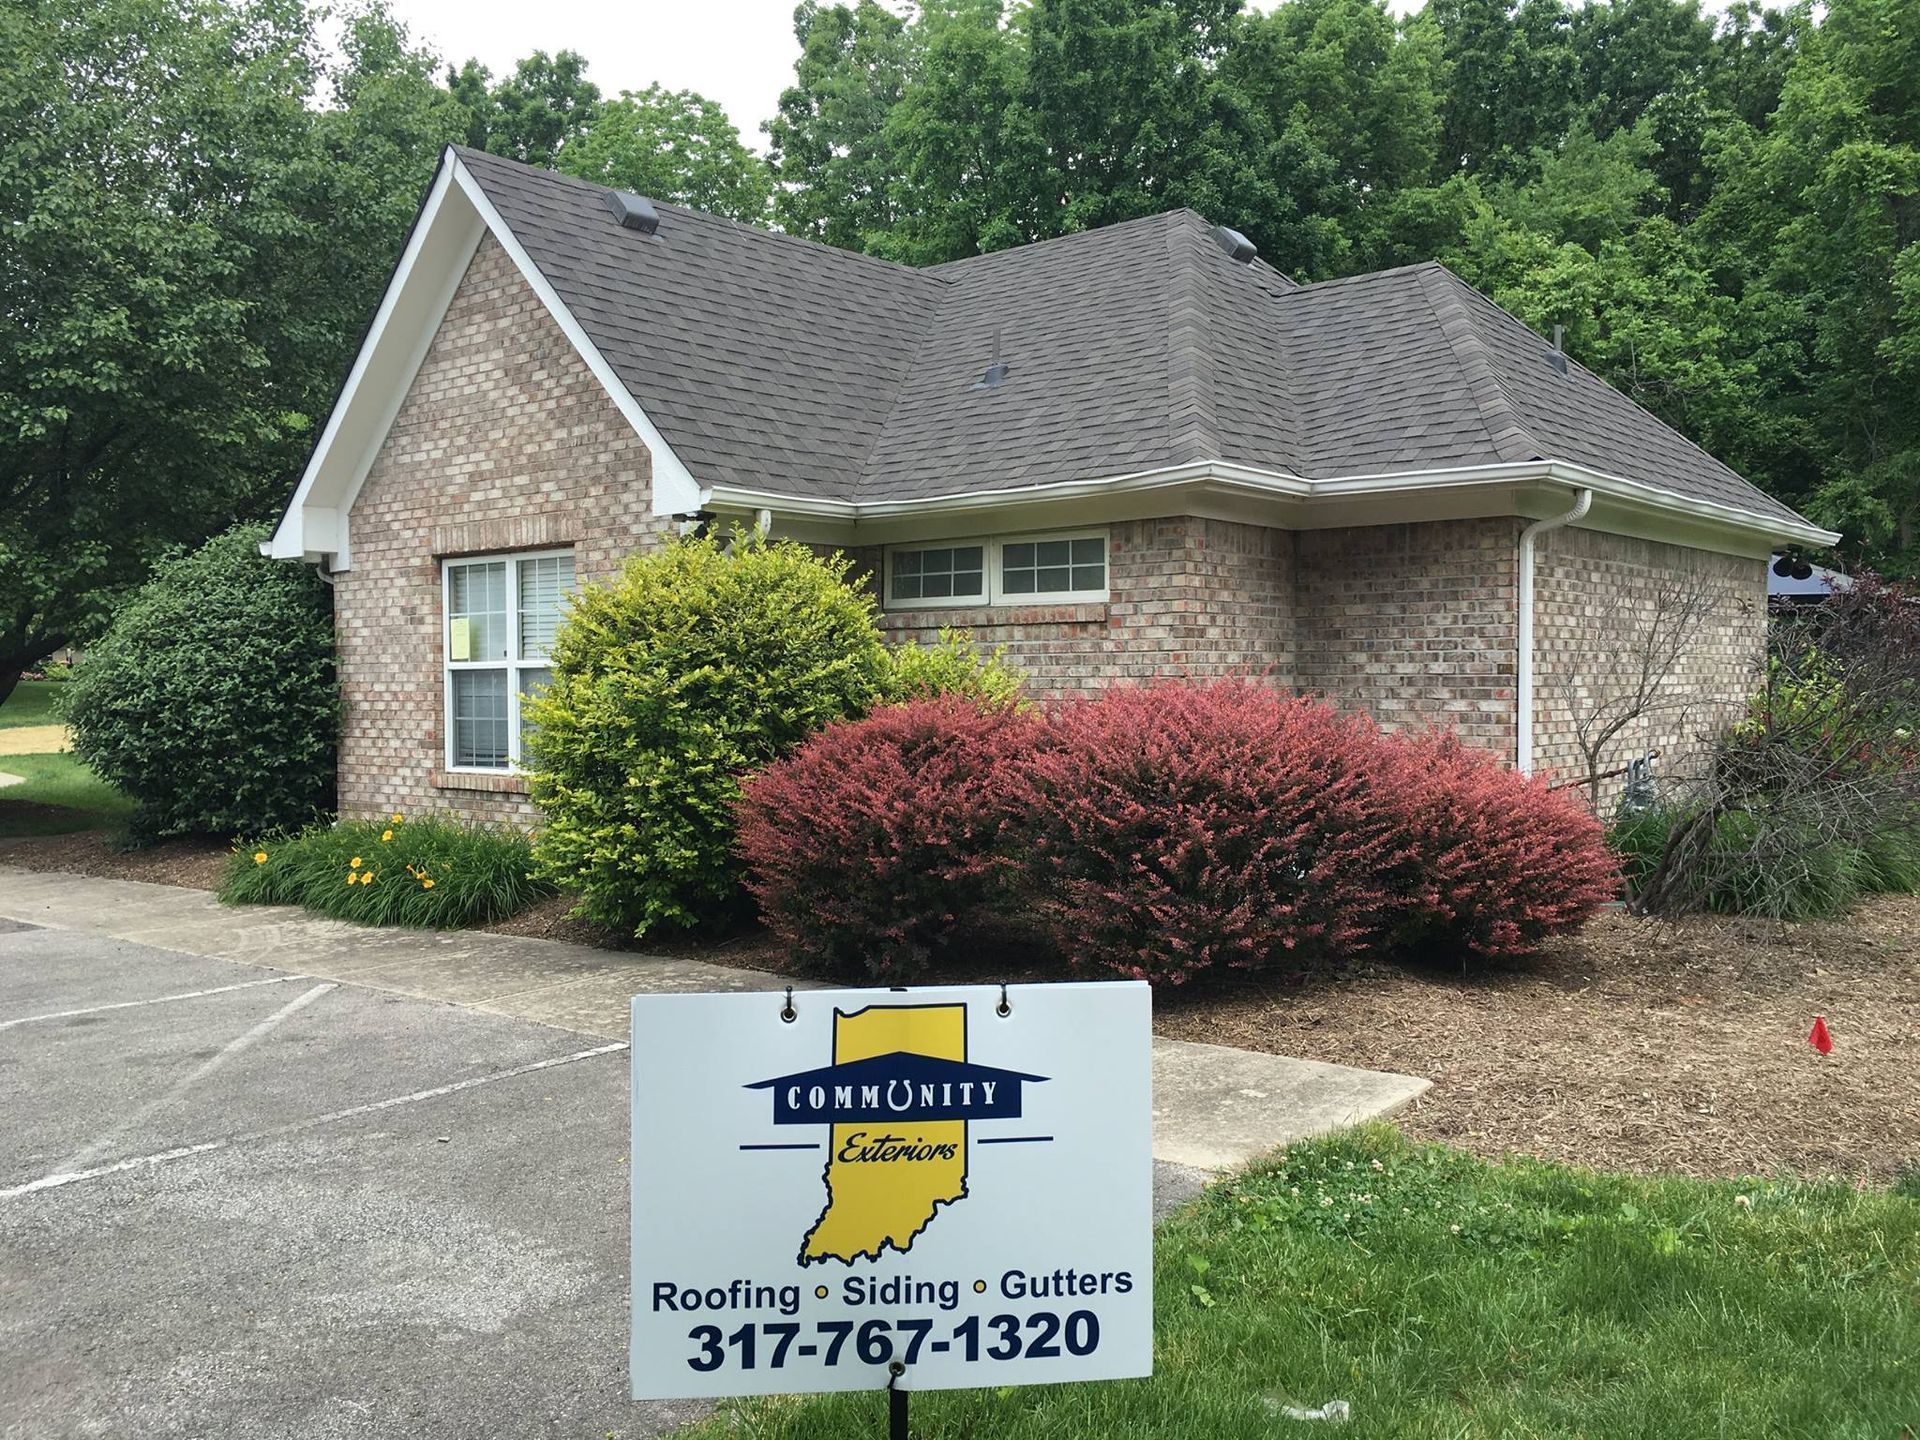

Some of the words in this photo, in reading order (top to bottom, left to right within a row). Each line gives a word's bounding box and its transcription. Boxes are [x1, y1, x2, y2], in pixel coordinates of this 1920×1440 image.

[787, 1079, 997, 1111] COMMUNITY
[837, 1132, 957, 1163] Exteriors
[653, 1280, 800, 1314] Roofing
[842, 1275, 959, 1307] Siding
[1000, 1269, 1133, 1300] Gutters
[687, 1310, 1100, 1372] 317-767-1320
